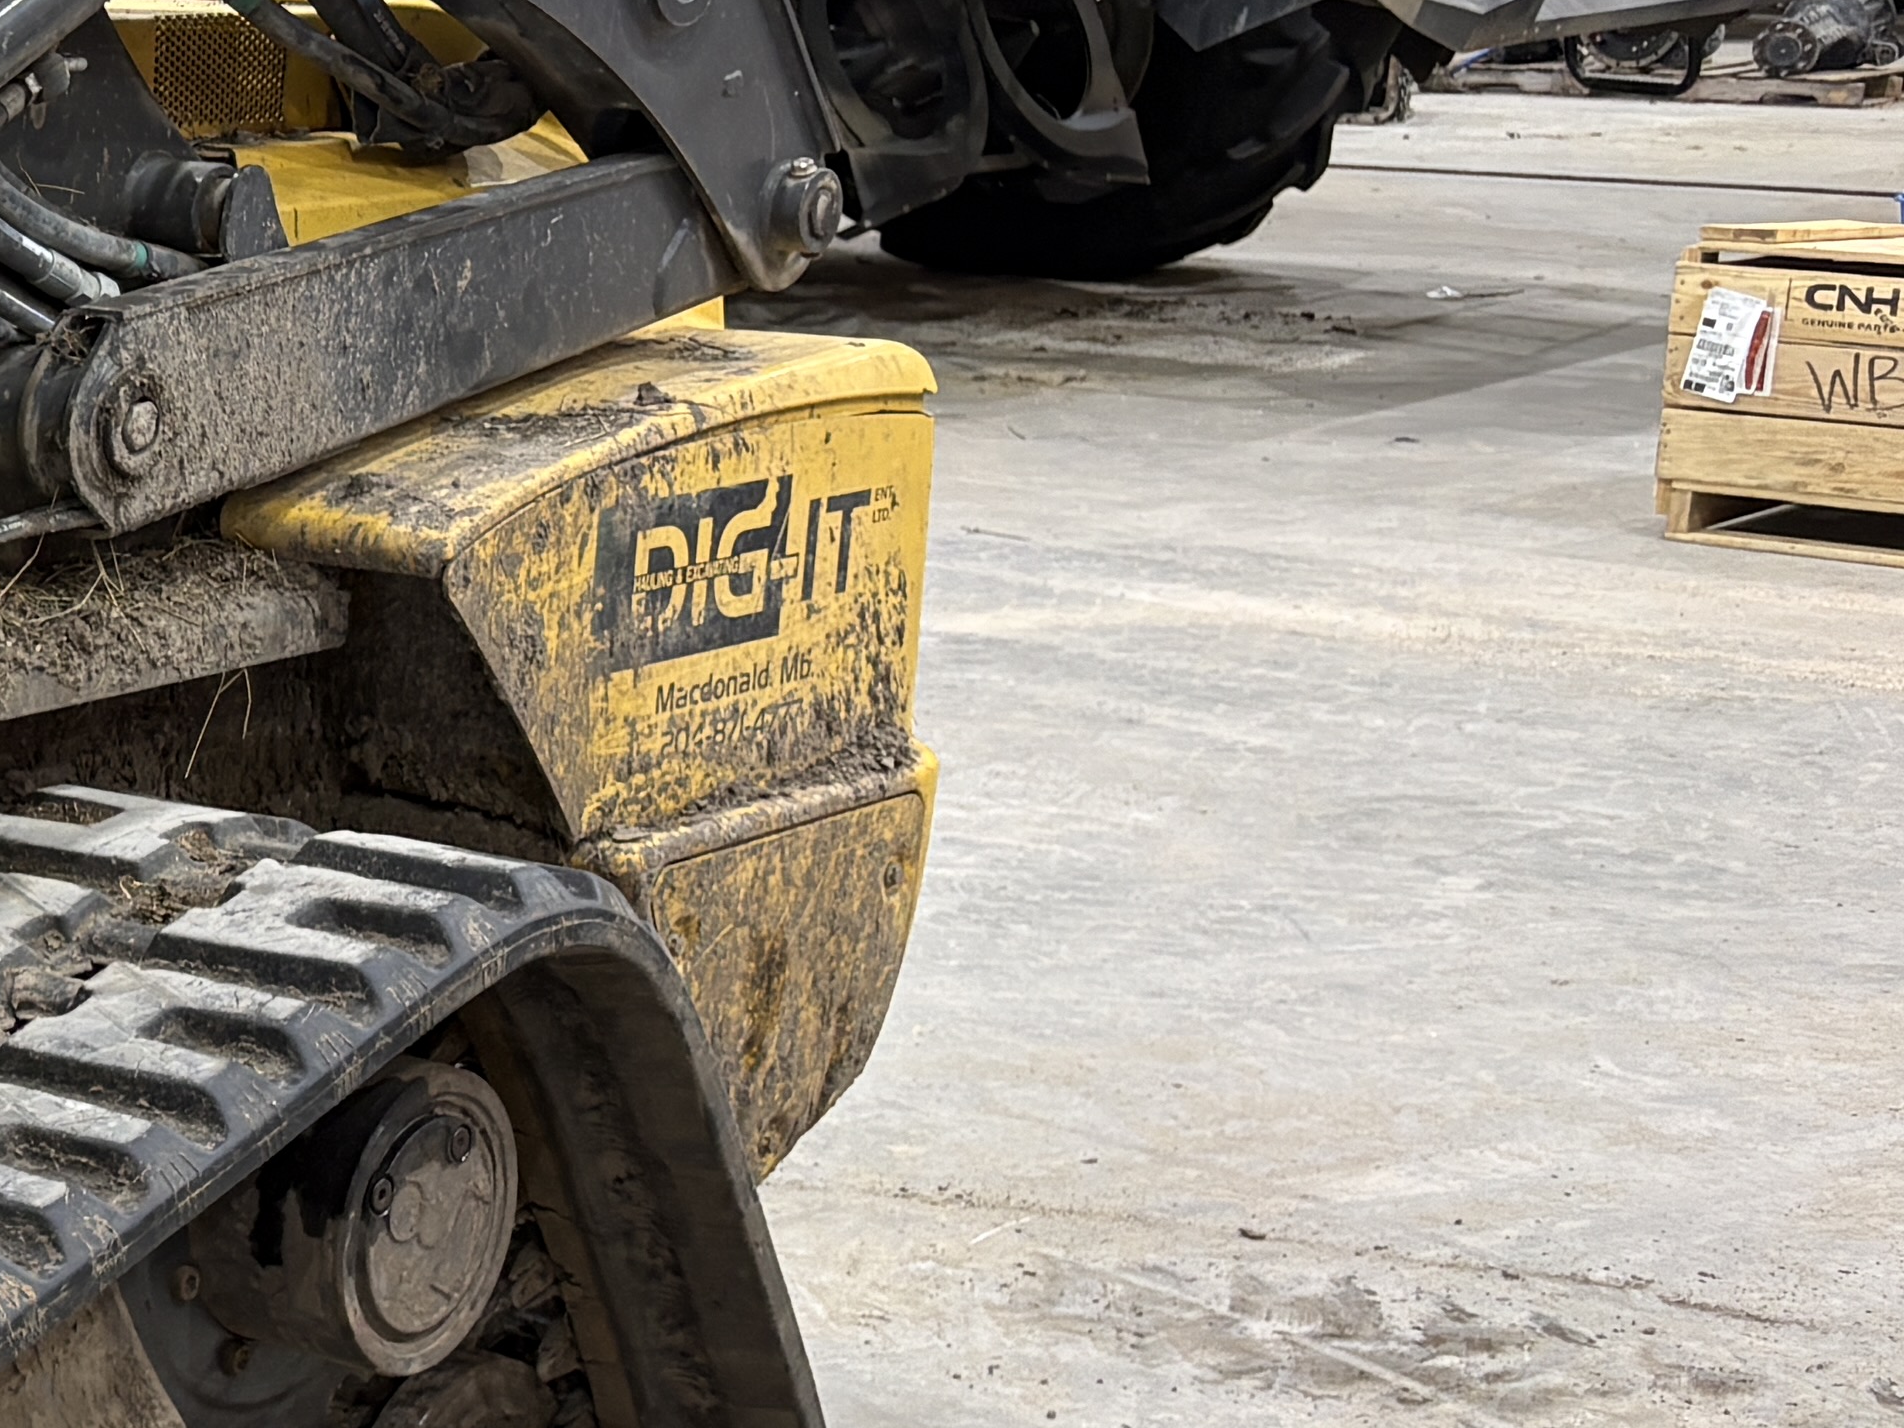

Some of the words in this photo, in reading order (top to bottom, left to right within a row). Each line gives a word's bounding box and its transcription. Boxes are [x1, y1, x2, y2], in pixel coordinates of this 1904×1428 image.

[1805, 284, 1891, 317] CNH
[1801, 318, 1855, 330] GENUINE
[634, 568, 674, 593] HAULING
[686, 555, 740, 582] EXCAVATING
